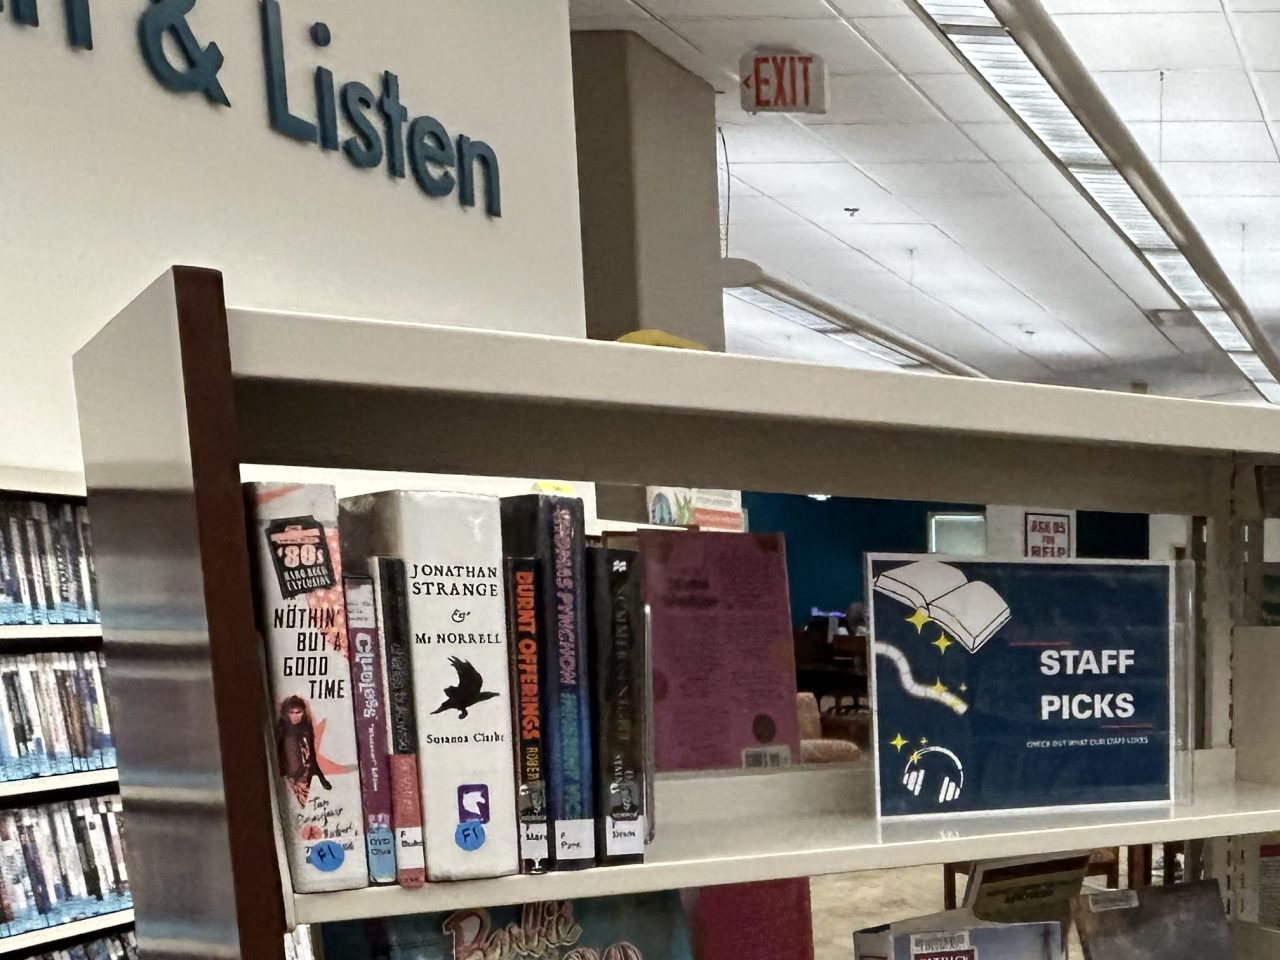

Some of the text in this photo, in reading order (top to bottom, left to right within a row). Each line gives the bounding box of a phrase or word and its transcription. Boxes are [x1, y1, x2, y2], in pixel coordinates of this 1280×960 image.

[754, 56, 814, 107] EXIT
[138, 0, 502, 217] & Listen
[410, 563, 498, 579] JONATHAN
[412, 582, 498, 597] STRANGE
[516, 570, 537, 634] BURNT
[297, 632, 342, 652] BUT A
[436, 633, 502, 645] NORRELL
[556, 592, 578, 685] PYNCHON
[283, 656, 328, 677] GOOD
[1040, 649, 1135, 676] STAFF
[308, 679, 346, 700] TIME
[517, 638, 540, 741] OFFERINGS
[1041, 692, 1136, 721] PICKS
[461, 826, 480, 844] F1
